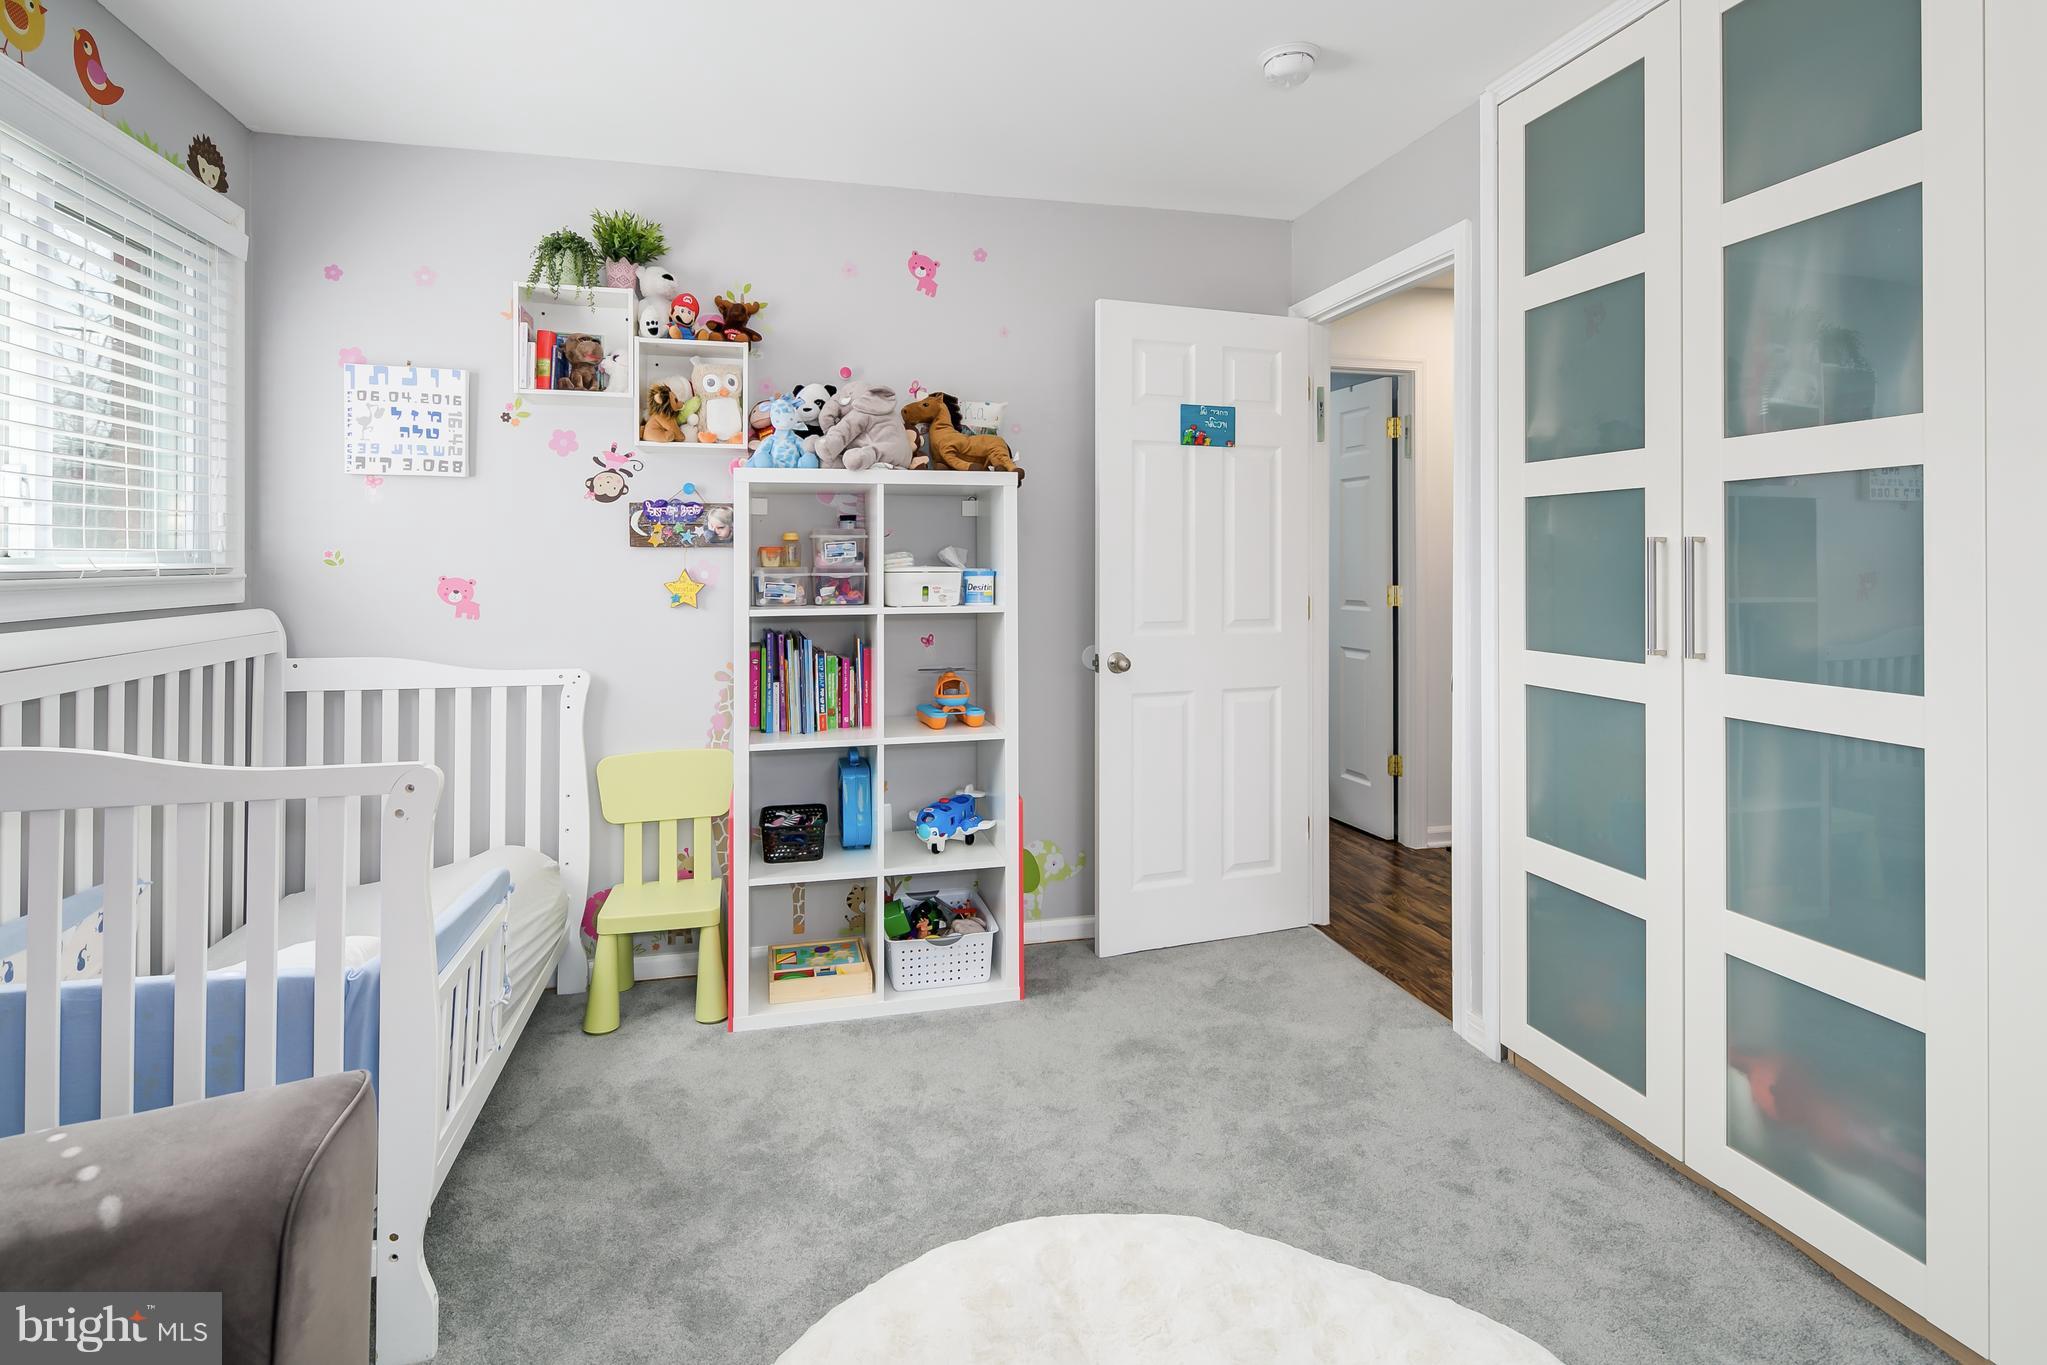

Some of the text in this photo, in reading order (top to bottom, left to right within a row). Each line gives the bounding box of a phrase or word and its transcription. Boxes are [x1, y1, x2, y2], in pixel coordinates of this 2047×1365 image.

[345, 364, 462, 389] יונתן
[357, 390, 462, 406] 06.04.2016
[390, 406, 442, 423] מזל
[399, 424, 440, 439] טלה
[357, 442, 445, 457] שבוע 39
[402, 457, 463, 473] 3.068
